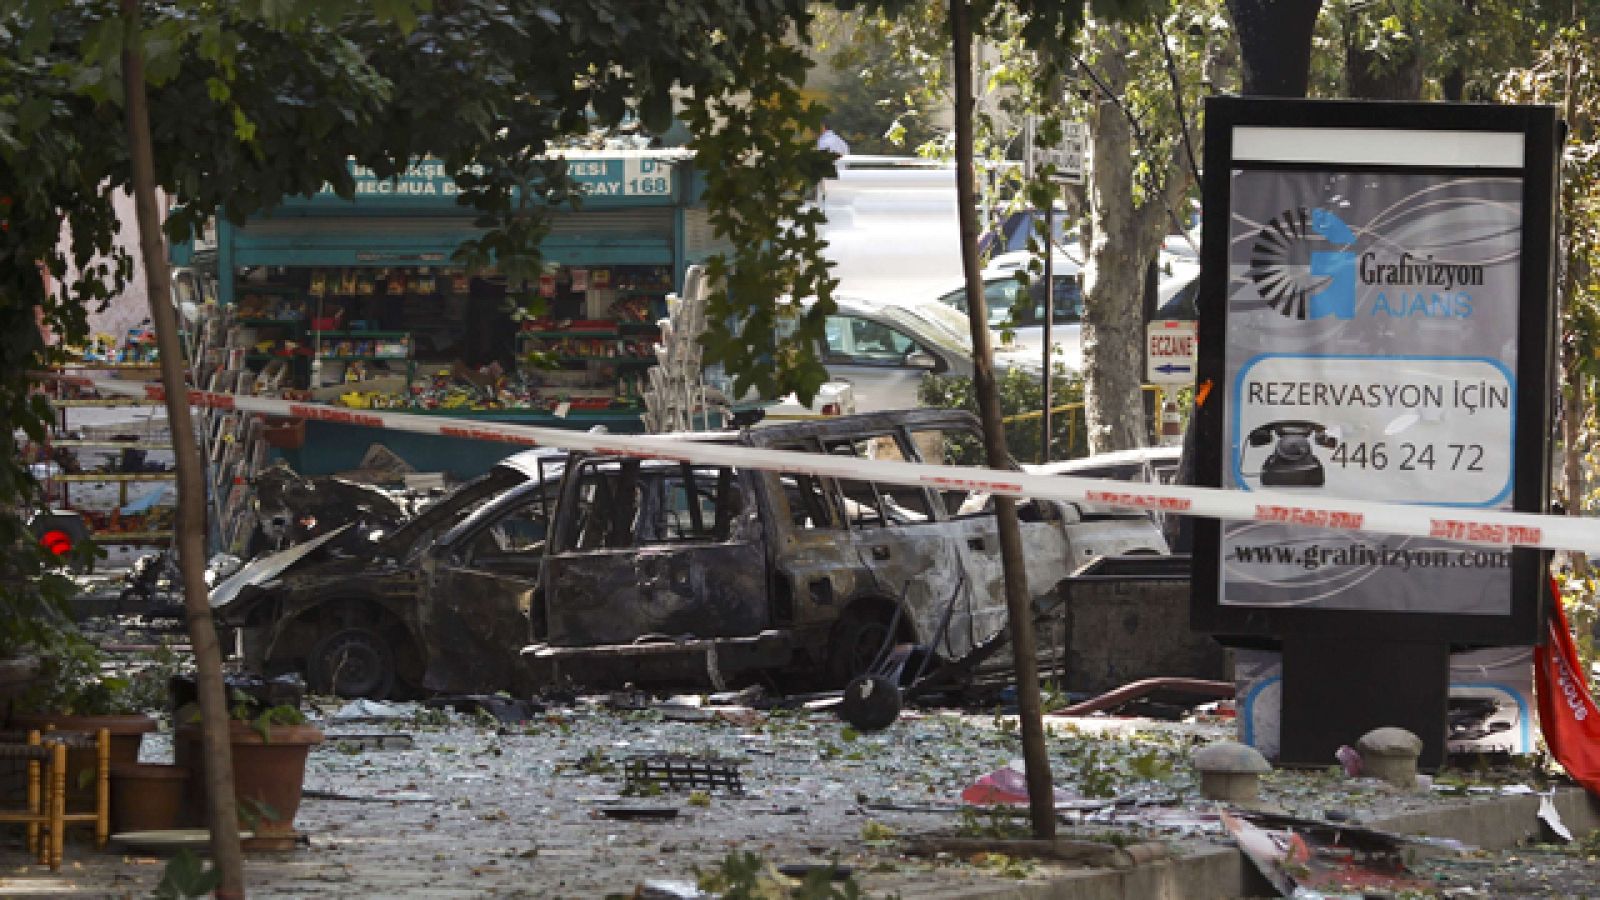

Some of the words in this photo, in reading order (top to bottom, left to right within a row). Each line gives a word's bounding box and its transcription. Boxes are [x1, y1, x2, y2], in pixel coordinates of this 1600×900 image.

[630, 178, 666, 194] 168
[1359, 252, 1483, 289] Grafivizyon
[1370, 292, 1474, 319] AJANS
[1151, 335, 1193, 357] ECZANE
[1248, 382, 1443, 408] REZERVASYON
[1453, 380, 1509, 414] İÇİN
[1330, 442, 1388, 470] 446
[1400, 444, 1436, 471] 24
[1449, 444, 1484, 472] 72
